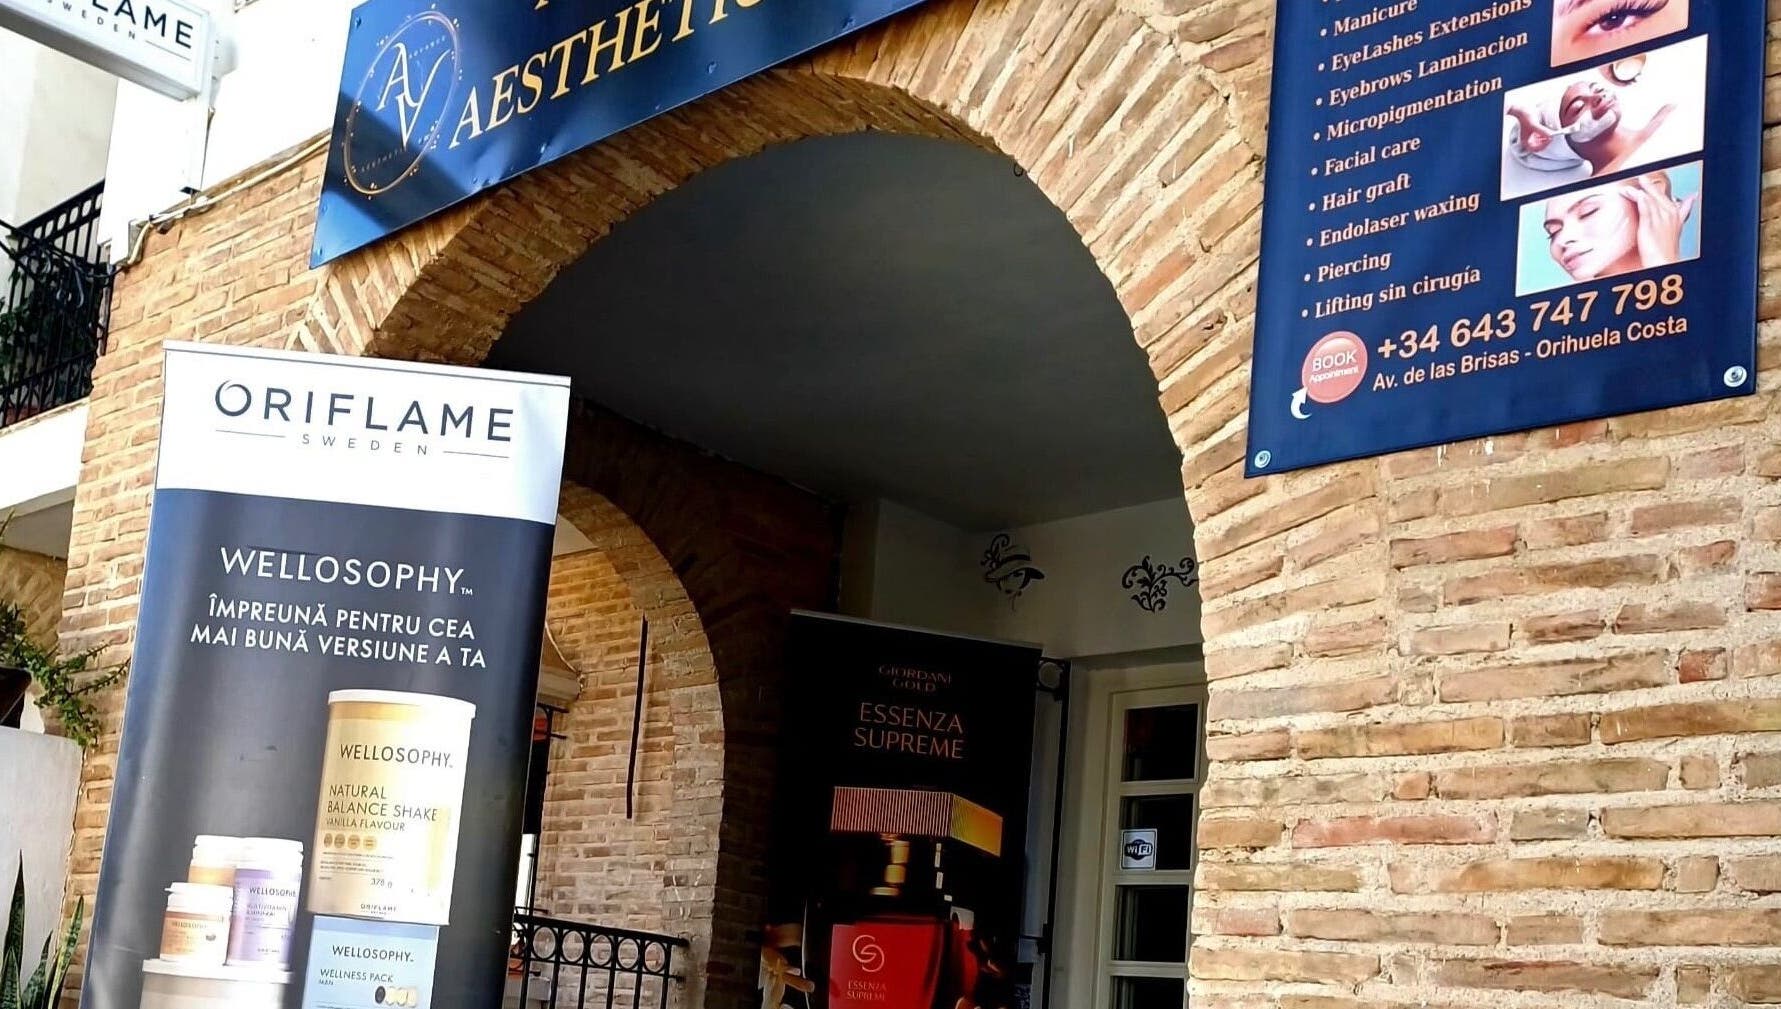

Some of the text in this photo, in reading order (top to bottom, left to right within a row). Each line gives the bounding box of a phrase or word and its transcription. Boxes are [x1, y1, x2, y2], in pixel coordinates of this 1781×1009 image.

[46, 0, 136, 40] WEDEN
[1331, 0, 1532, 71] EyeLashes Extensions
[1333, 0, 1418, 37] Manicure
[1329, 31, 1528, 107] Eyebrows Laminacion
[1326, 75, 1503, 142] Micropigmentation
[1324, 137, 1421, 176] Facial care
[1321, 172, 1411, 212] Hair graft
[1319, 192, 1481, 247] Endolaser waxing
[1317, 252, 1392, 283] Piercing
[1314, 265, 1481, 318] Lifting sin cirugía
[1377, 273, 1685, 359] +34 643 747 798
[1312, 349, 1358, 373] BOOK
[1372, 373, 1398, 391] Av.
[1404, 366, 1426, 386] de
[1430, 362, 1456, 380] las
[1461, 345, 1520, 374] Brisas
[1536, 327, 1622, 359] Orihuela
[1626, 315, 1688, 342] Costa
[214, 379, 514, 443] ORIFLAME
[301, 433, 428, 456] SWEDEN
[208, 592, 476, 640] ÎMPREUNĂ PENTRU CEA
[190, 623, 487, 669] MAI BUNĂ VERSIUNE A TA
[892, 678, 937, 693] GOLD
[859, 702, 964, 735] ESSENZA
[853, 727, 964, 760] SUPREME
[327, 801, 438, 821] BALANCE SHAKE
[329, 784, 387, 800] NATURAL
[326, 817, 406, 832] VANILLA FLAVOUR
[320, 968, 394, 983] WELLNESS PACK
